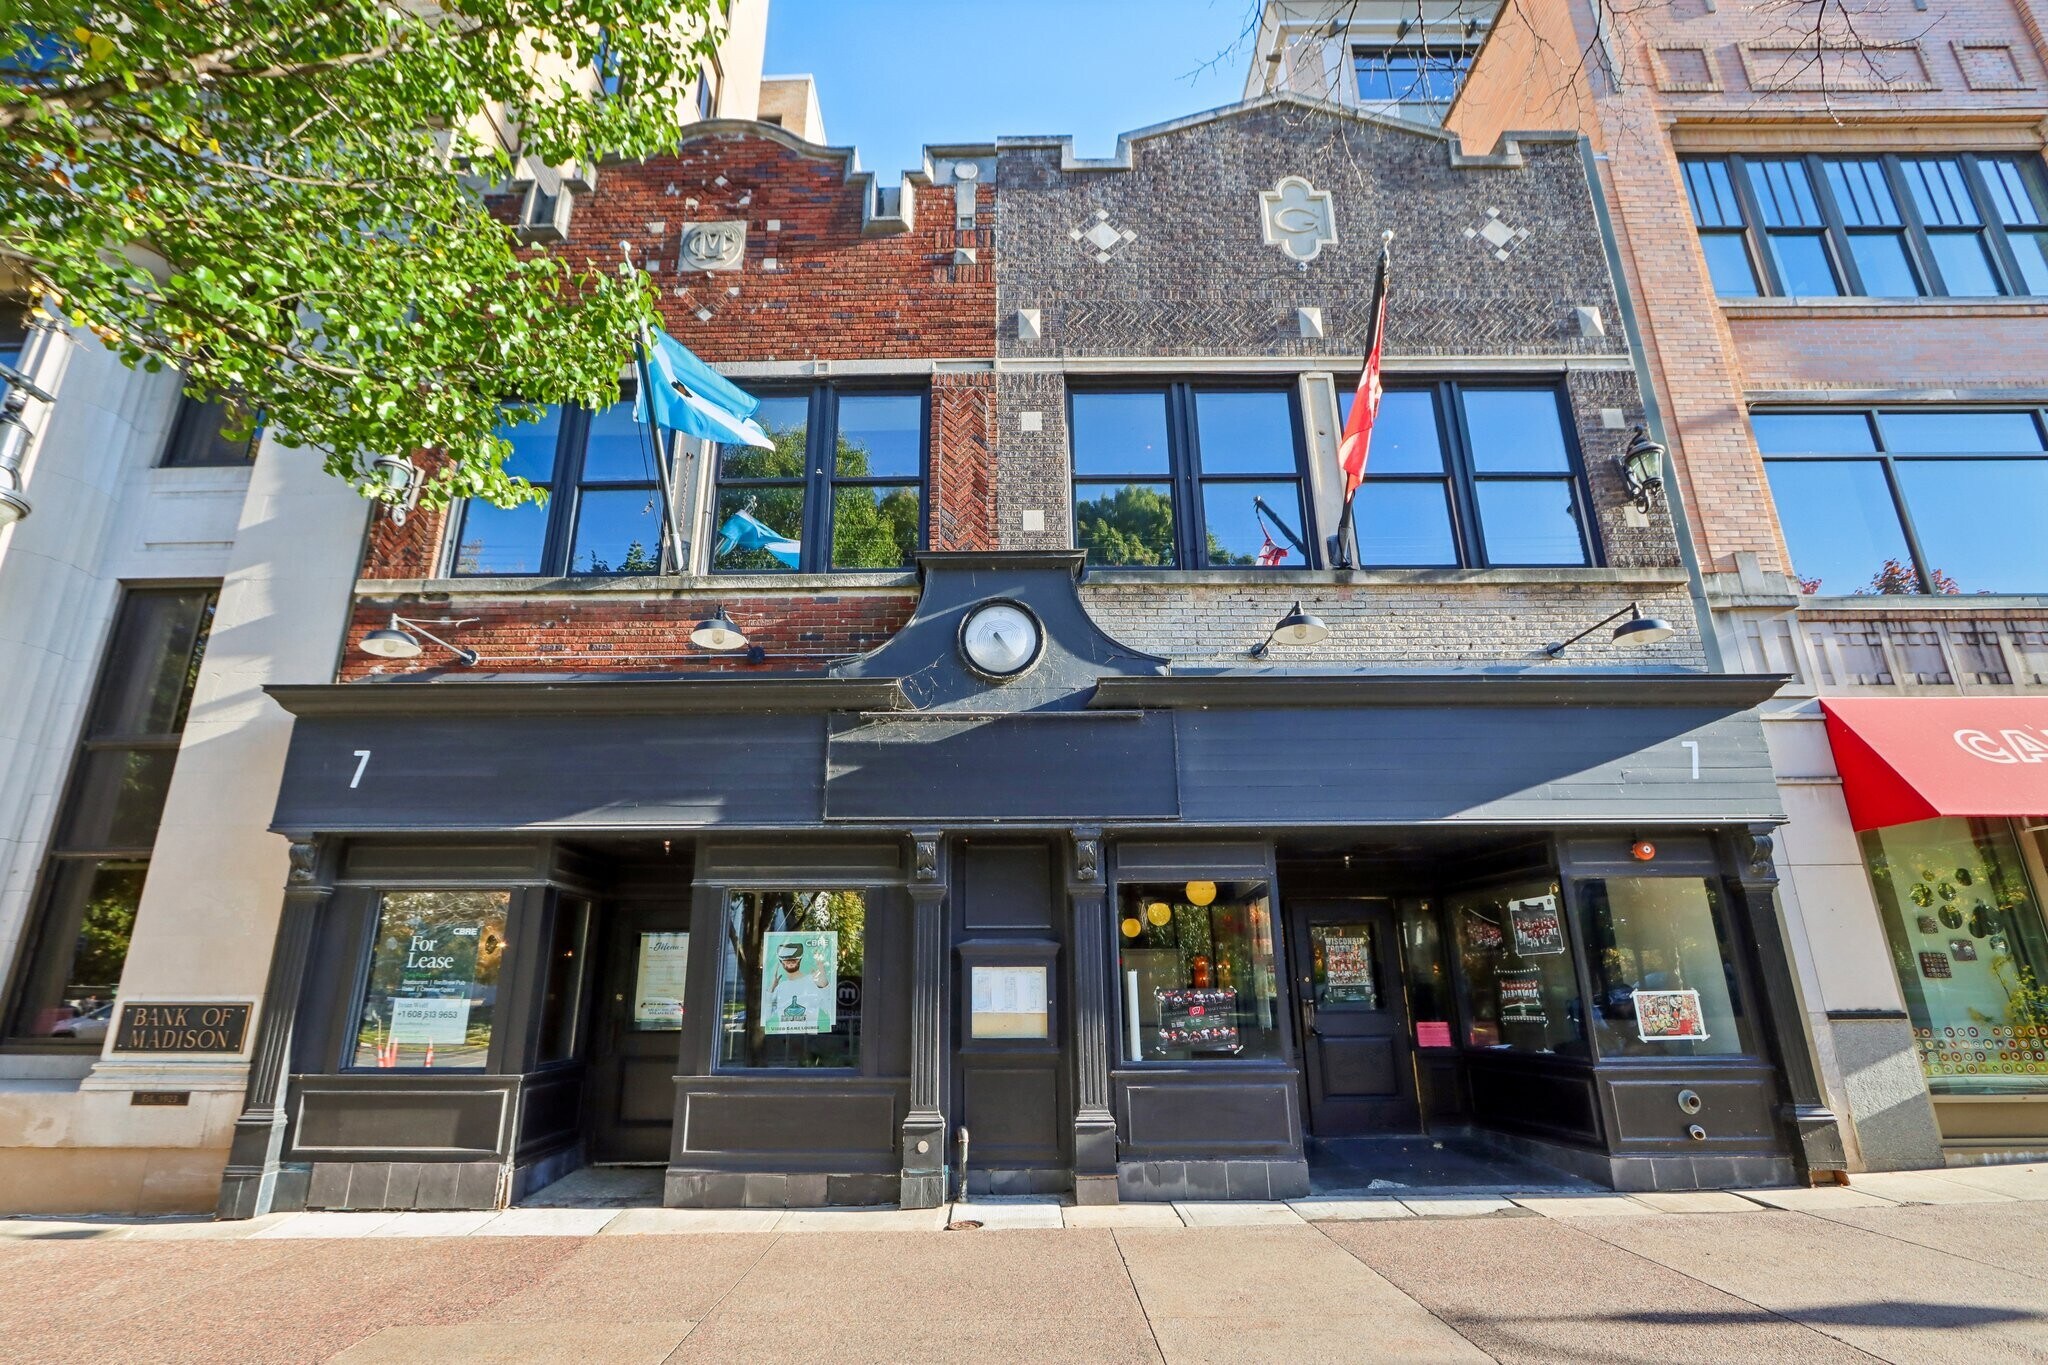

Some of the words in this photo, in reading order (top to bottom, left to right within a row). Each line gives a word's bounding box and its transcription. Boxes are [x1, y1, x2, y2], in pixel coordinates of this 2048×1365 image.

[1953, 728, 2048, 764] CA
[350, 750, 371, 788] 7
[1681, 741, 1699, 779] 7
[453, 927, 478, 935] CBRE
[409, 935, 438, 952] For
[805, 939, 829, 947] CBRE
[406, 952, 454, 969] Lease
[133, 1008, 190, 1027] BANK
[202, 1008, 235, 1027] OF
[407, 1010, 422, 1018] 608
[128, 1029, 231, 1049] MADISON
